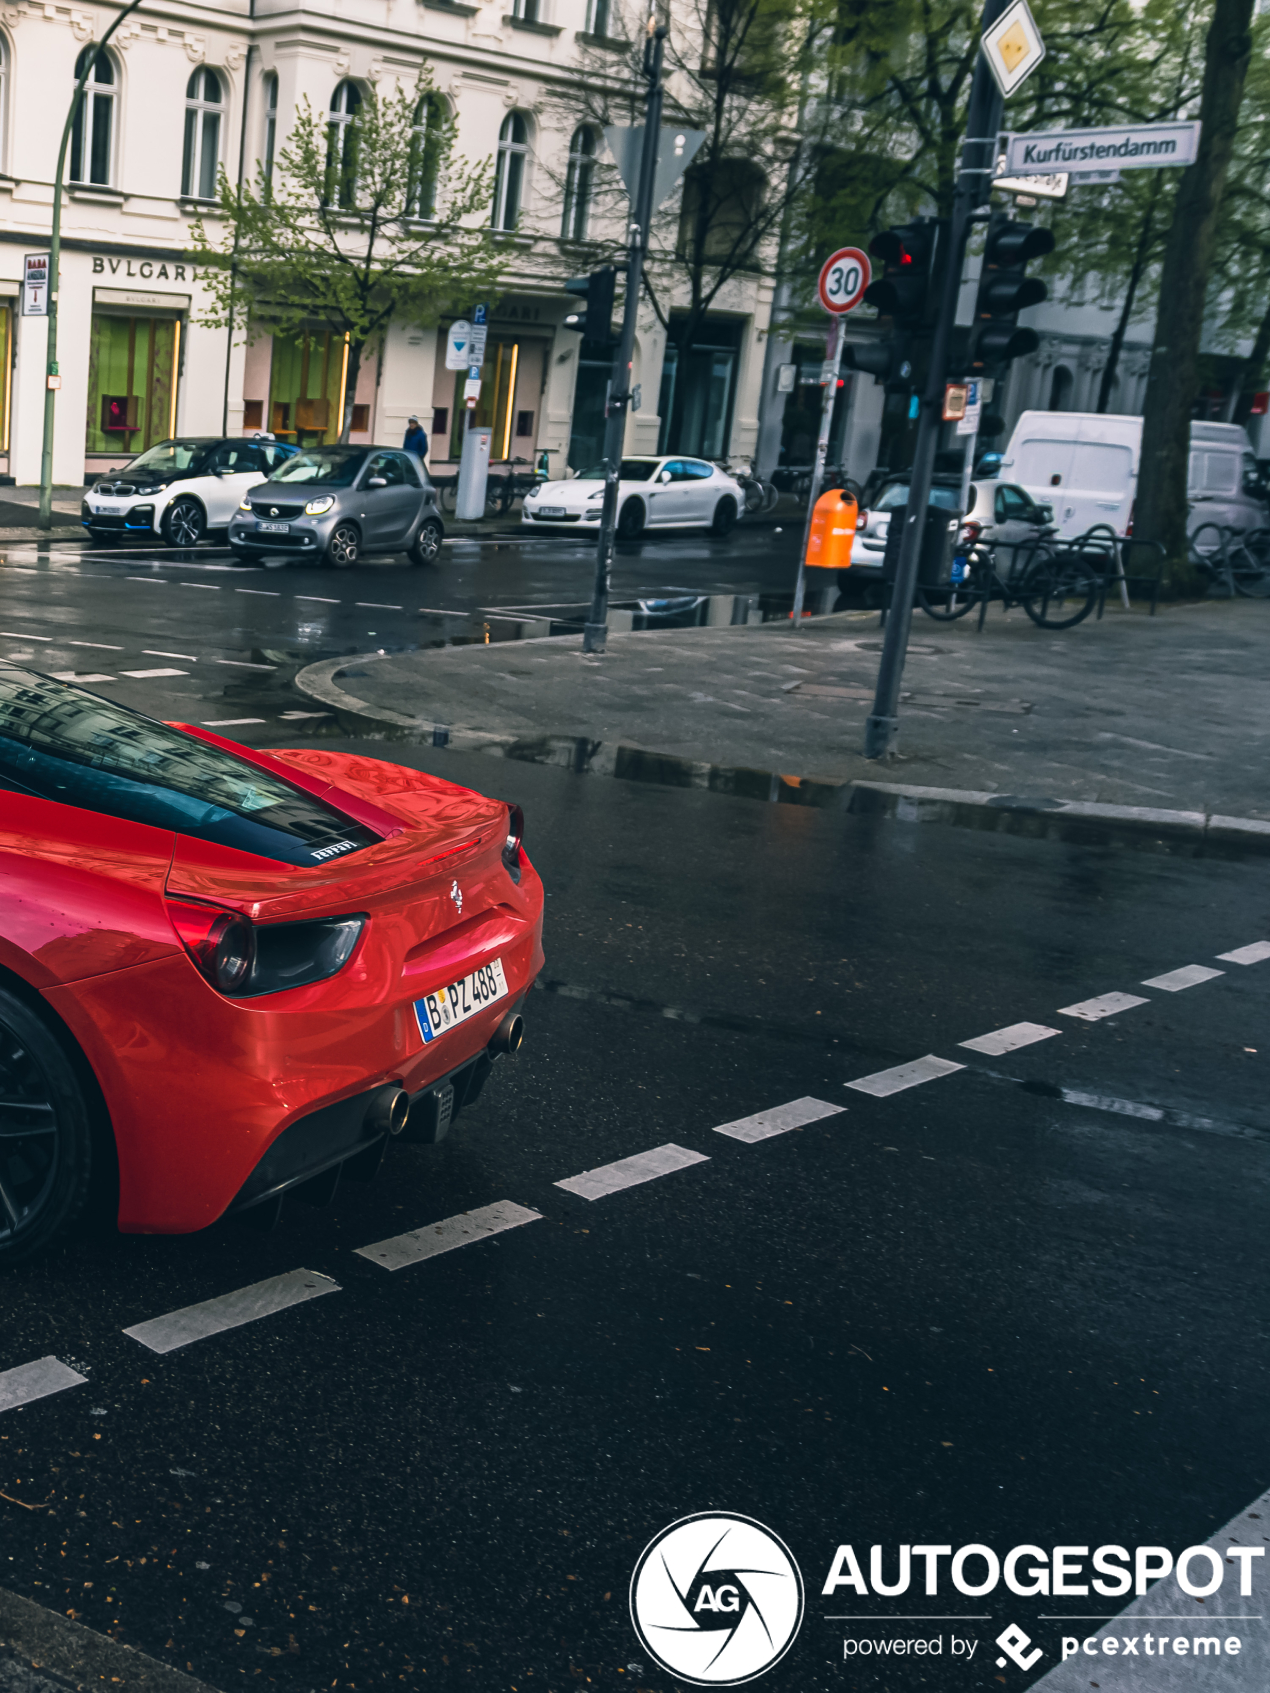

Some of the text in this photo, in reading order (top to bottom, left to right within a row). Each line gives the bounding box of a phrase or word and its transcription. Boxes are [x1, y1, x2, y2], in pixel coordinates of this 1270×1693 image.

[1023, 137, 1177, 164] Kurfürstendamm
[92, 256, 199, 282] BVLGARI
[828, 266, 859, 296] 30
[310, 840, 358, 861] Ferrari
[425, 964, 498, 1031] B PZ 488
